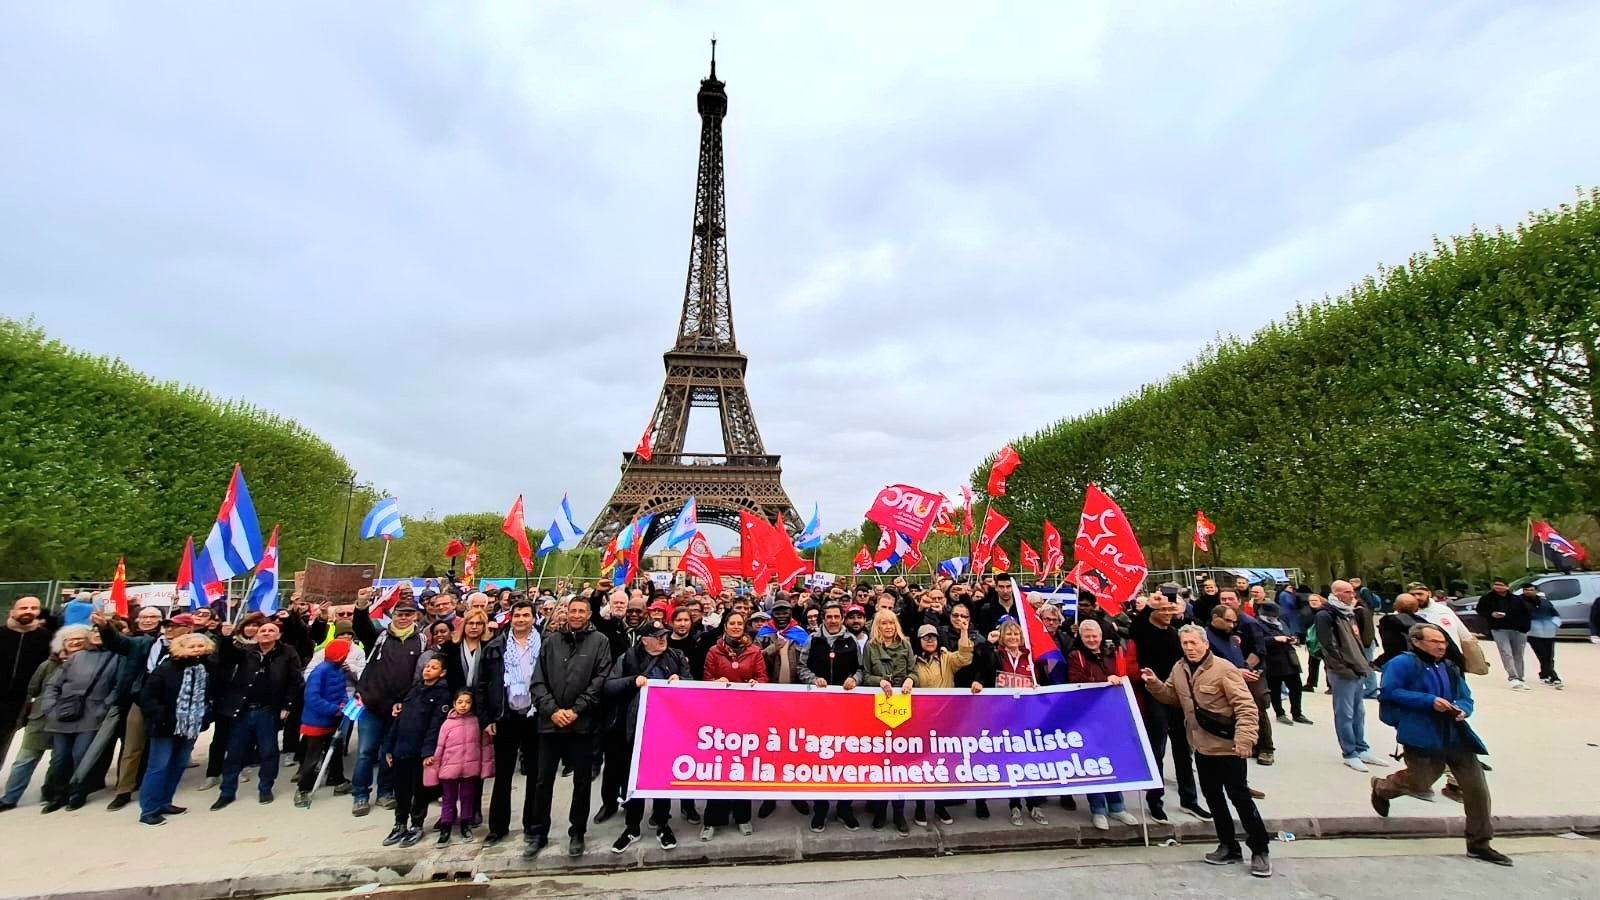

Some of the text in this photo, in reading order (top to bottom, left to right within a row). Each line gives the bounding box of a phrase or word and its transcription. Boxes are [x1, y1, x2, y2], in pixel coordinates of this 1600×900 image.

[998, 673, 1032, 689] STOP
[893, 708, 908, 716] PCF
[697, 725, 1084, 760] Stop à l'agression impérialiste
[671, 752, 1114, 787] Oui à la souveraineté des peuples
